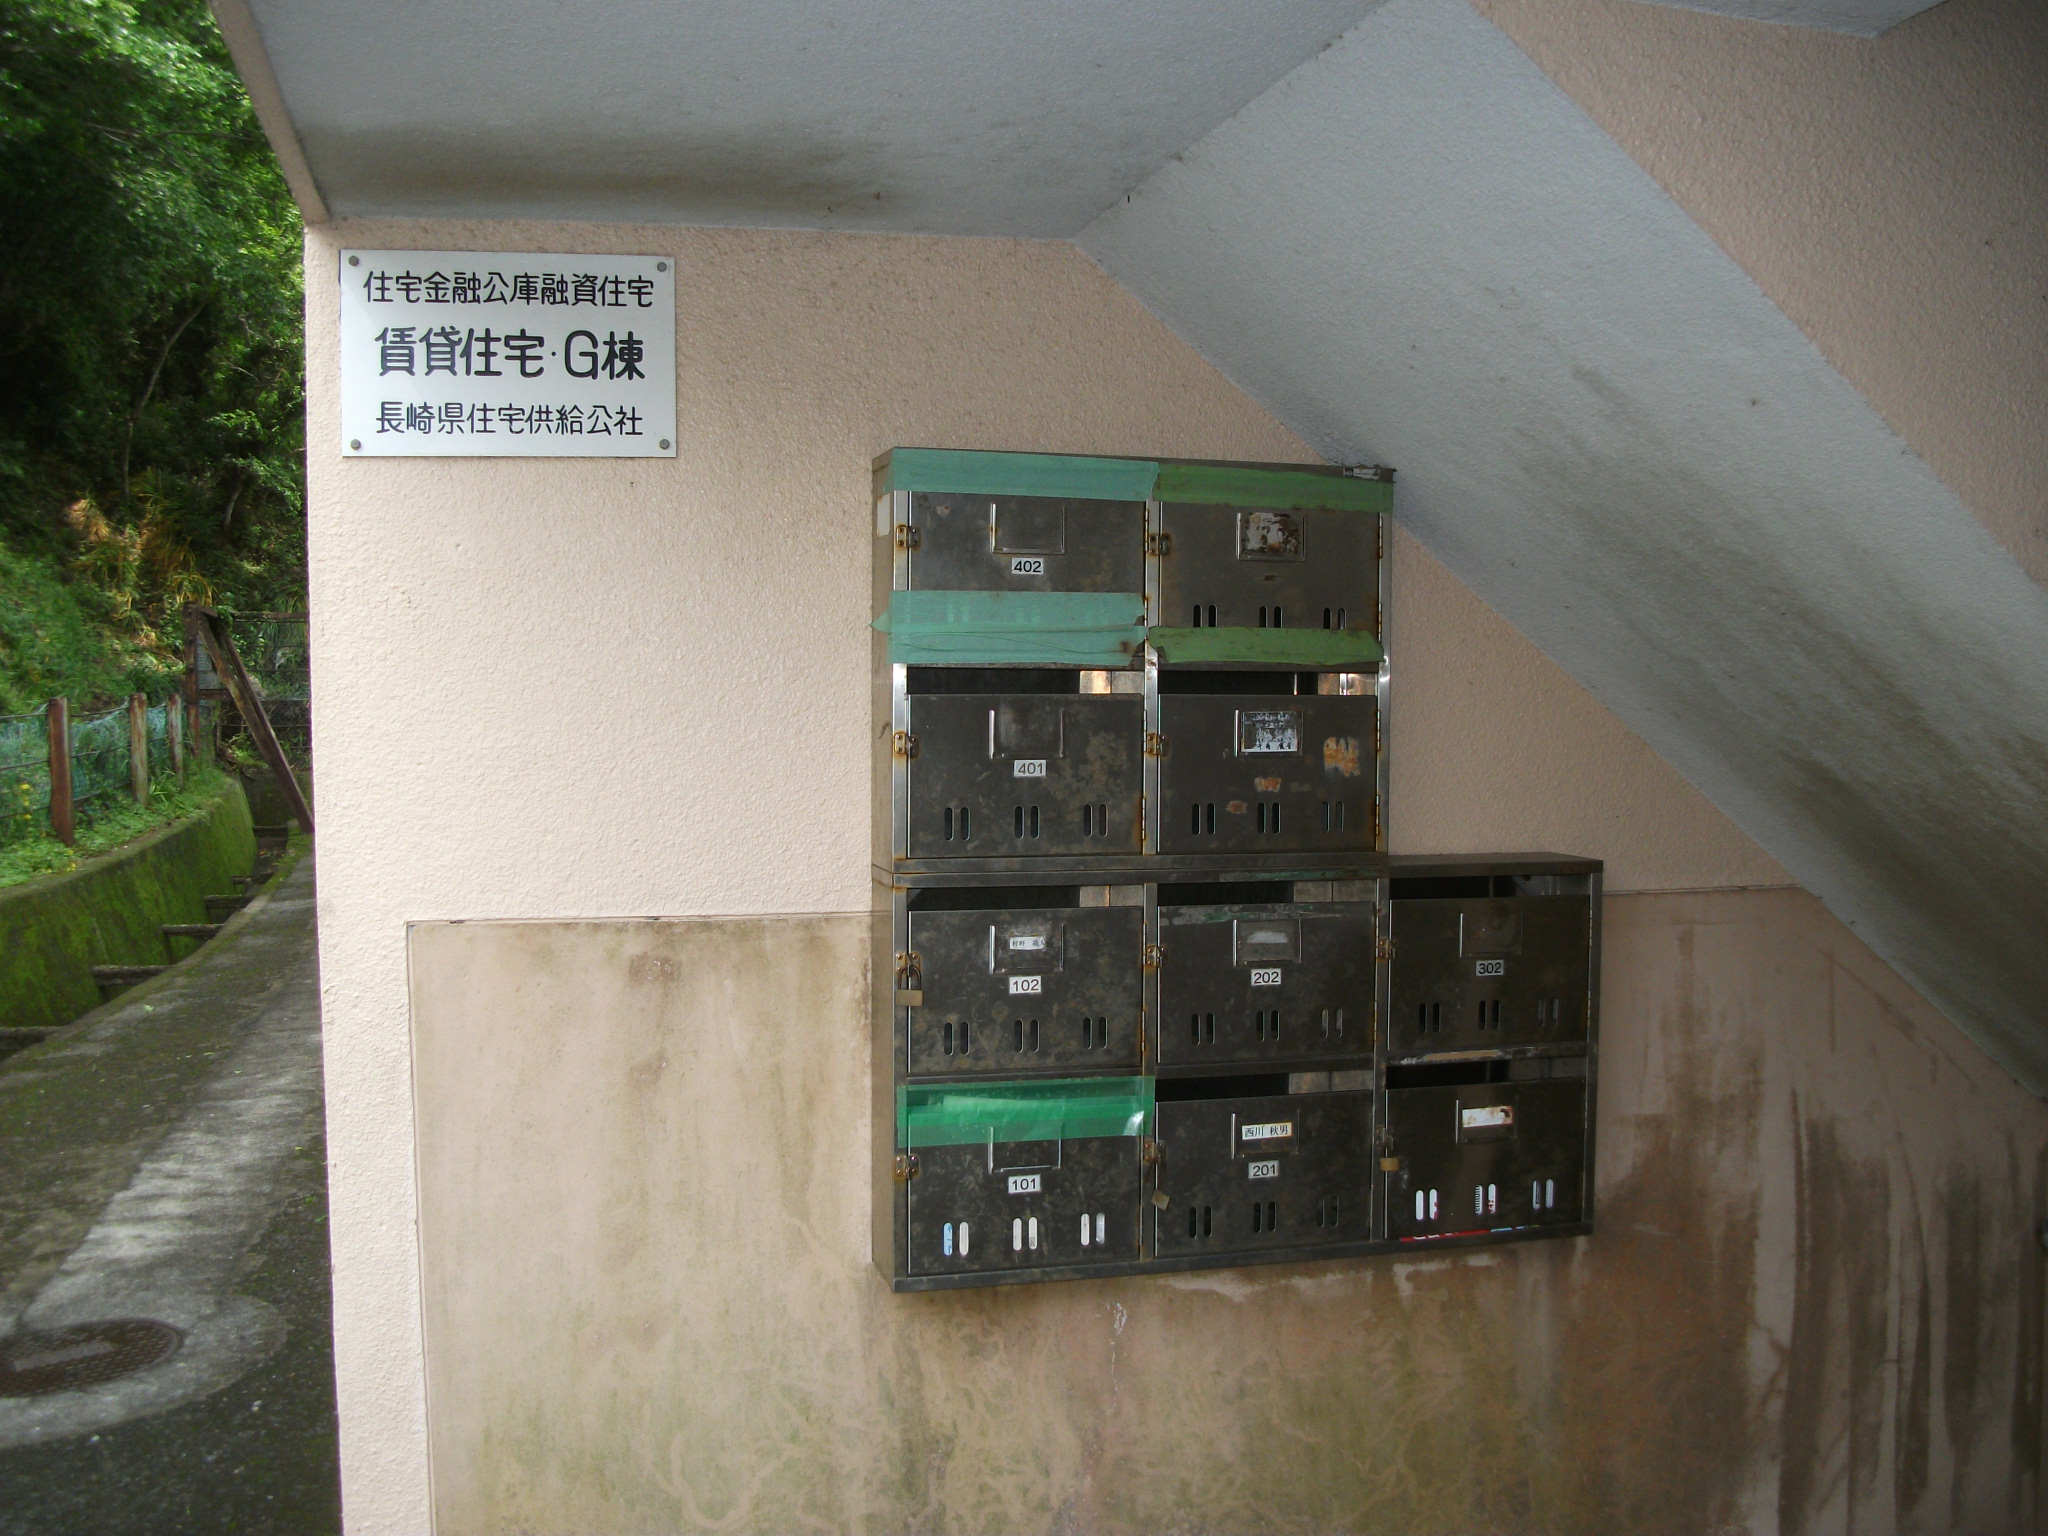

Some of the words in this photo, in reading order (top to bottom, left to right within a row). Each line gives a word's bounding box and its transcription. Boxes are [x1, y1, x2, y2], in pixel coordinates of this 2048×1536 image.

[363, 270, 655, 308] 住宅金融公庫融資住宅
[375, 401, 643, 436] 長崎県住宅供給公社
[1014, 560, 1042, 573] 402
[1018, 763, 1043, 776] 401
[1478, 962, 1502, 975] 302
[1254, 972, 1279, 984] 202
[1013, 979, 1040, 992] 102
[1252, 1164, 1277, 1177] 201
[1012, 1178, 1037, 1191] 101
